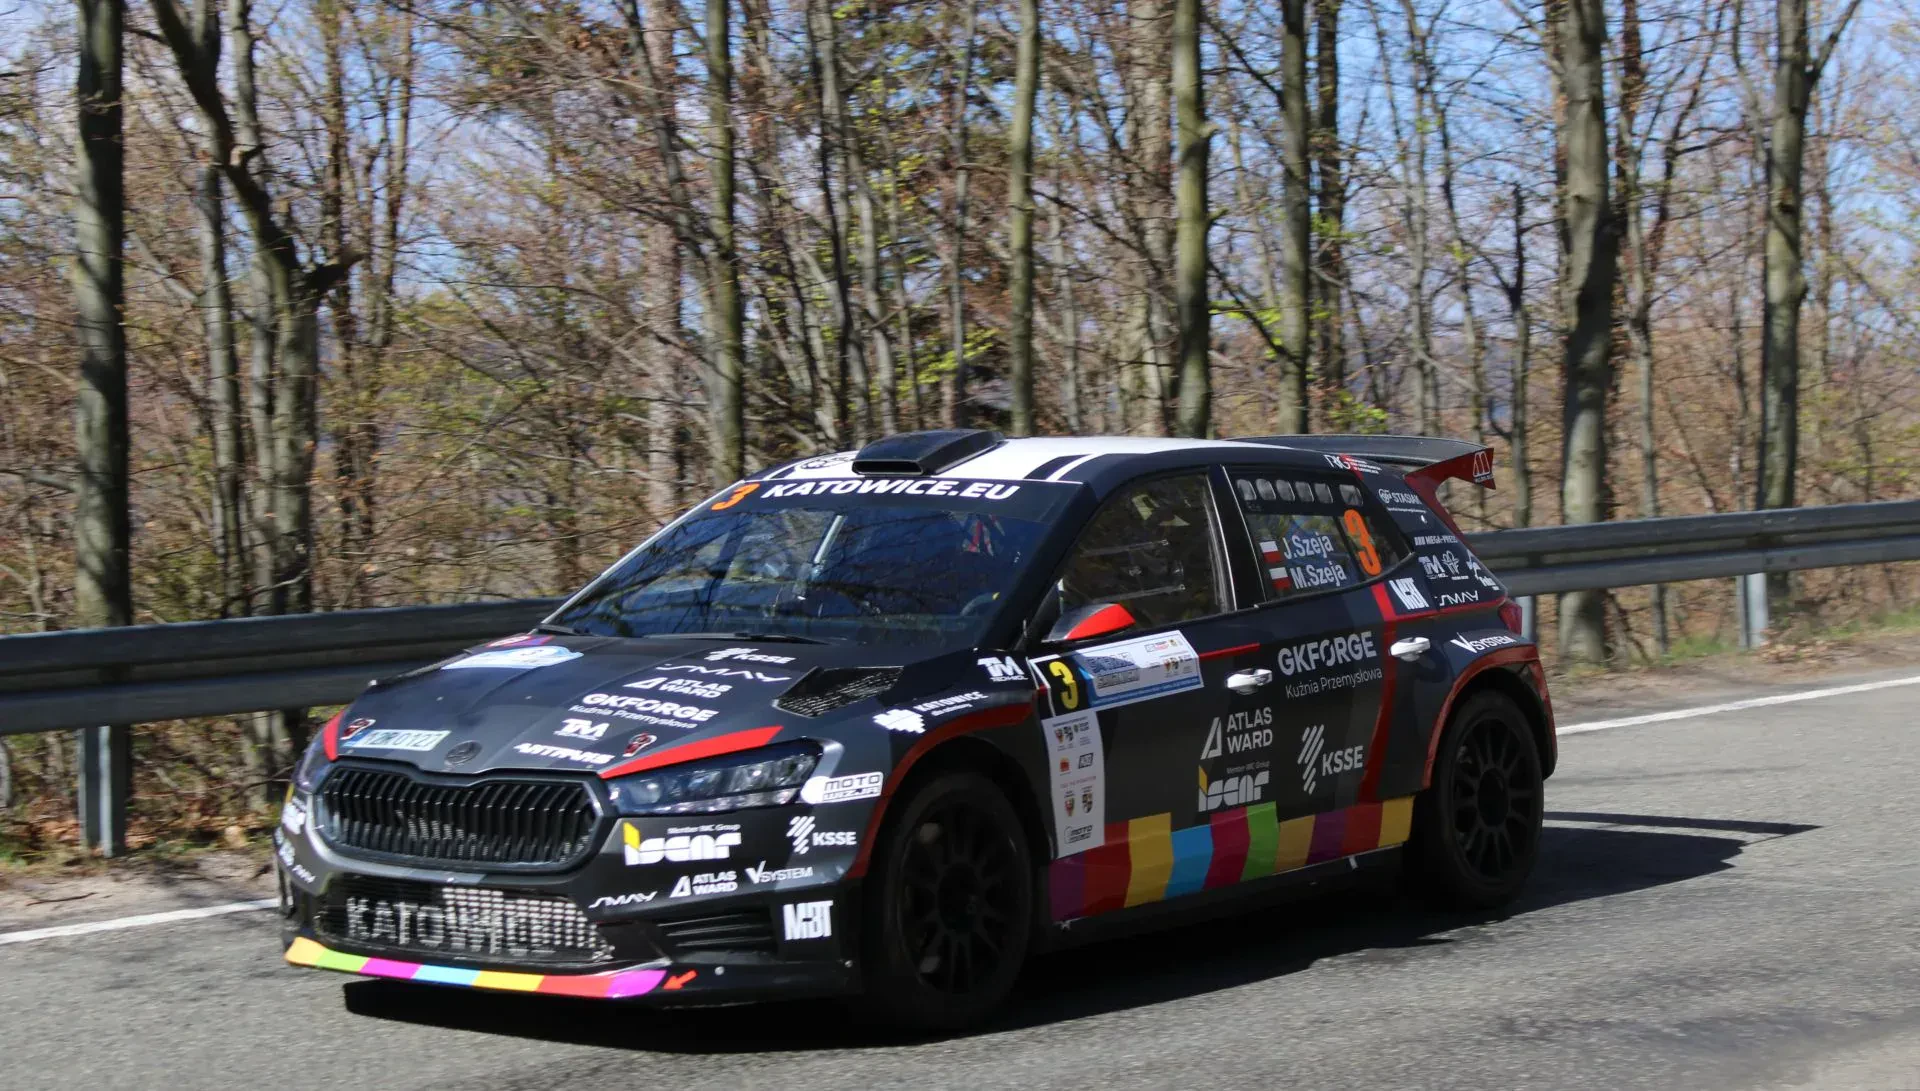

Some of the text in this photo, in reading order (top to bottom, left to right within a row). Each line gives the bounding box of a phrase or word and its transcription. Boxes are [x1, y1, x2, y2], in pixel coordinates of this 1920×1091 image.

[711, 483, 760, 511] 3
[761, 480, 1020, 501] KATOWICE.EU
[1283, 531, 1334, 560] J.Szeja
[1344, 509, 1383, 576] 3
[1290, 561, 1347, 590] M.Szeja
[1277, 631, 1377, 676] GKFORGE
[659, 683, 723, 699] WARD
[666, 678, 733, 693] ATLAS
[1048, 661, 1079, 710] 3
[1320, 666, 1383, 693] Przemysłowa
[582, 693, 720, 722] GKFORGE
[913, 691, 989, 712] KATOWICE
[1226, 706, 1273, 732] ATLAS
[1226, 729, 1273, 754] WARD
[1322, 745, 1364, 777] KSSE
[824, 774, 881, 792] MOTO
[813, 830, 857, 847] KSSE
[692, 870, 737, 884] ATLAS
[692, 881, 738, 896] WARD
